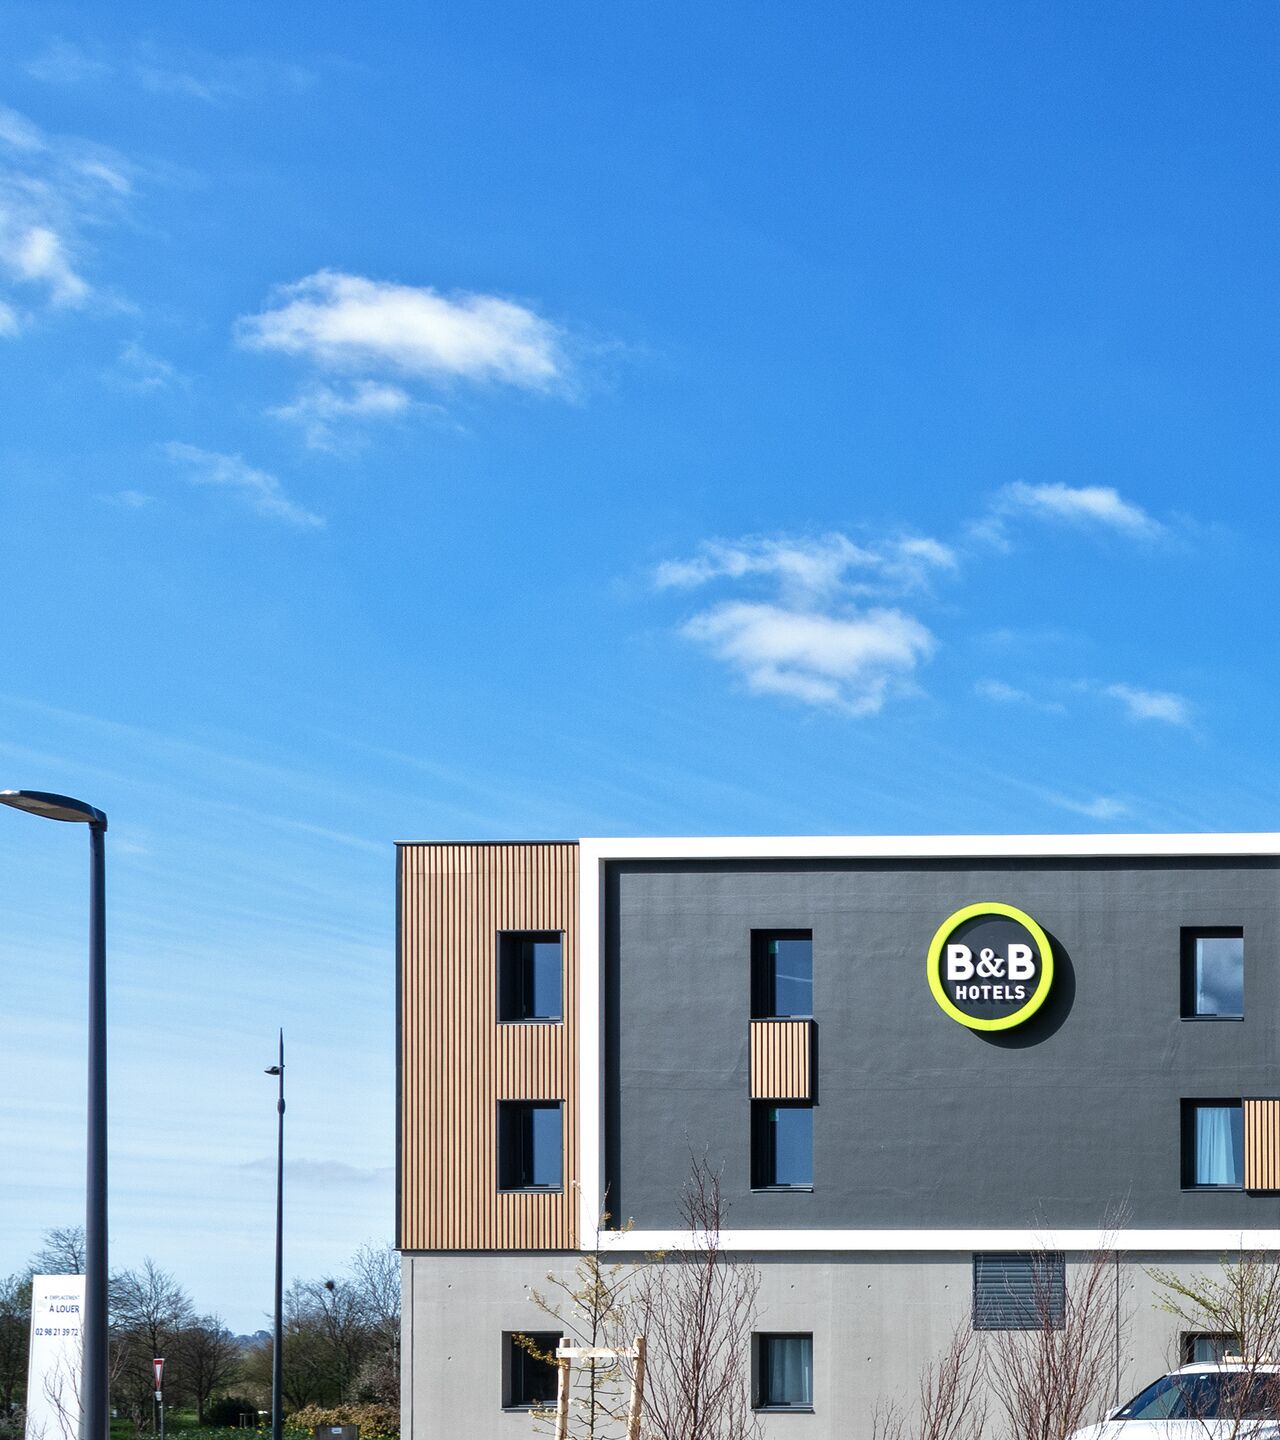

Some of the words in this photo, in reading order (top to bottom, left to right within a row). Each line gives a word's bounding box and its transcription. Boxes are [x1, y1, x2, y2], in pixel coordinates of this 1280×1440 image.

[947, 943, 1035, 981] B&B
[956, 985, 1025, 1000] HOTELS
[56, 1305, 80, 1313] LOUER
[35, 1328, 43, 1336] 02
[53, 1328, 60, 1336] 21
[71, 1328, 79, 1336] 72
